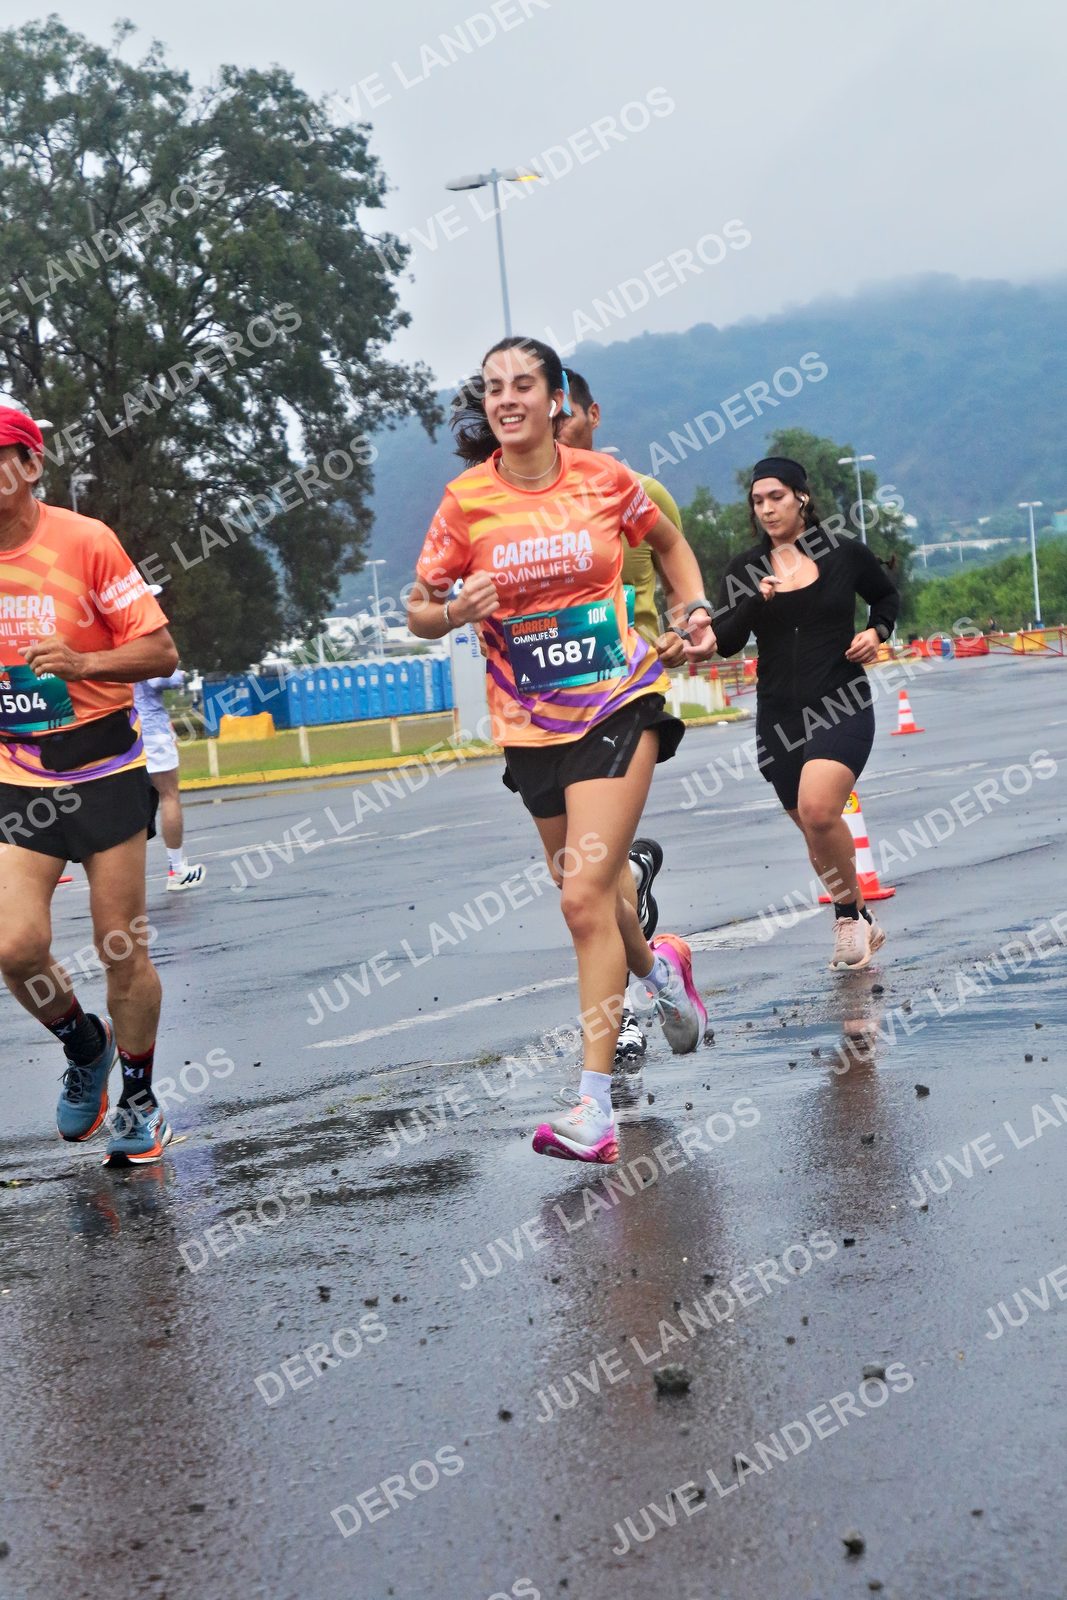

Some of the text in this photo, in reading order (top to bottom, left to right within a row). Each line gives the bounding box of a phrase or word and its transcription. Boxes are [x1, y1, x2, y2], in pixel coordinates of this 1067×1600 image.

[492, 529, 593, 569] CARRERA
[495, 559, 572, 586] OMNILIFE
[511, 616, 558, 635] CARRERA
[587, 606, 608, 625] 10K
[513, 632, 549, 645] OMNILIFE
[531, 637, 597, 669] 1687
[0, 692, 48, 714] 504
